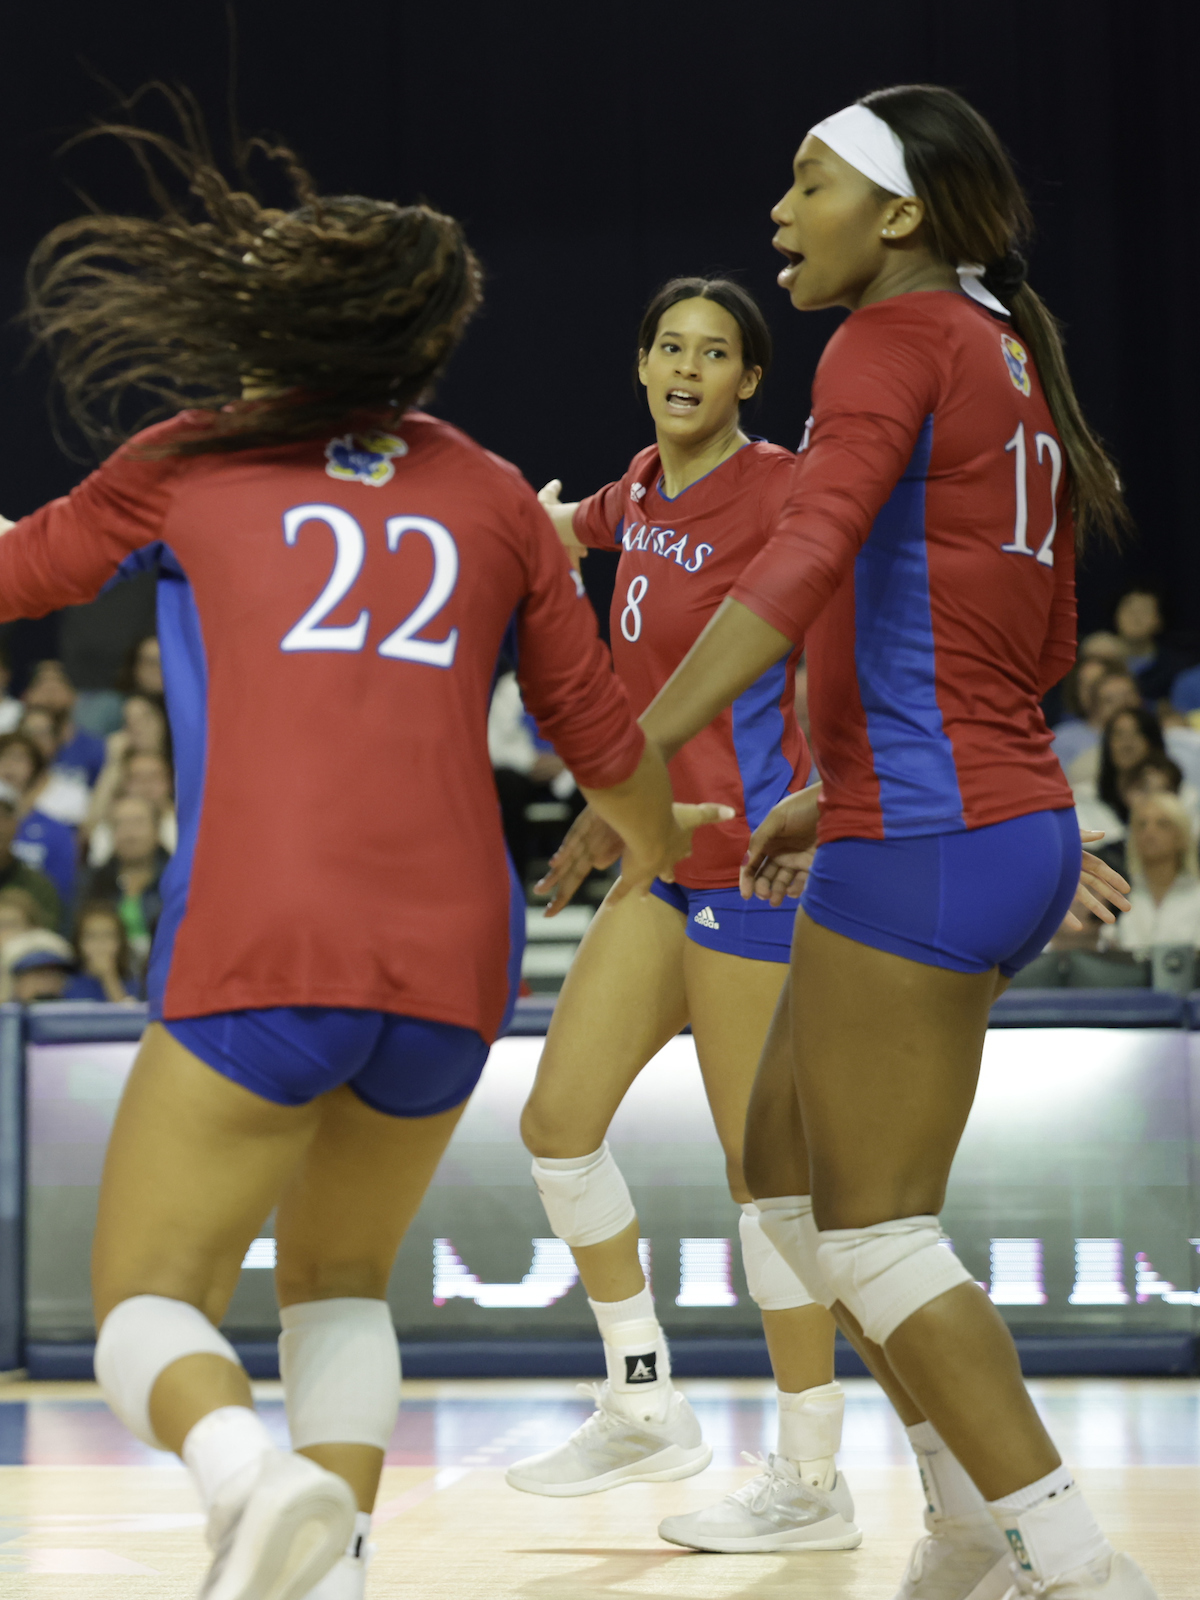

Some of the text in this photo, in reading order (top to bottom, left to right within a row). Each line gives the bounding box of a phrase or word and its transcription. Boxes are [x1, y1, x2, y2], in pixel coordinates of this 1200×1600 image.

[280, 502, 459, 669] 22
[620, 574, 649, 643] 8
[694, 915, 720, 930] adidas
